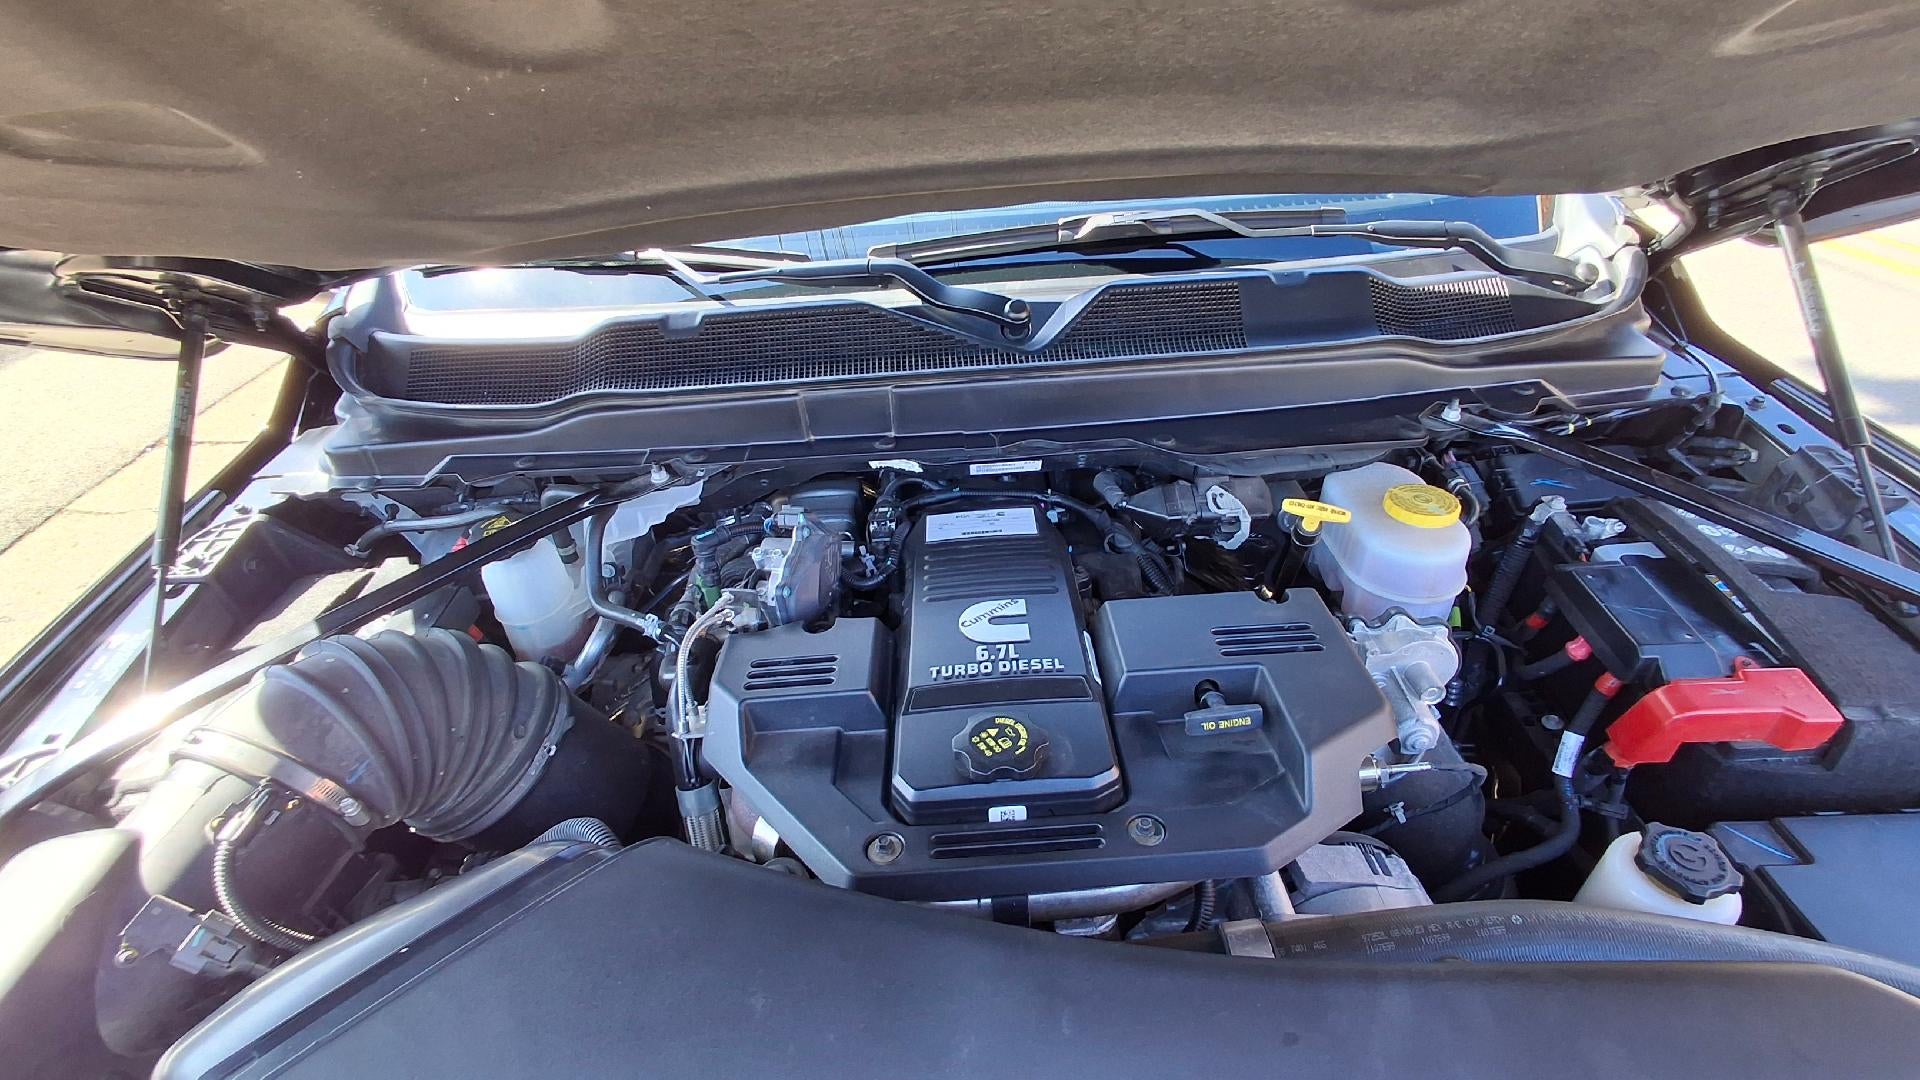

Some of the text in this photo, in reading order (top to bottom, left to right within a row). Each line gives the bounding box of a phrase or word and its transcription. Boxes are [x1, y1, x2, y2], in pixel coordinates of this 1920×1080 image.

[960, 598, 1020, 628] Cummins
[975, 643, 1020, 662] 6.7L
[929, 657, 1066, 680] TURBO DIESEL
[1201, 716, 1252, 731] ENGINE OIL
